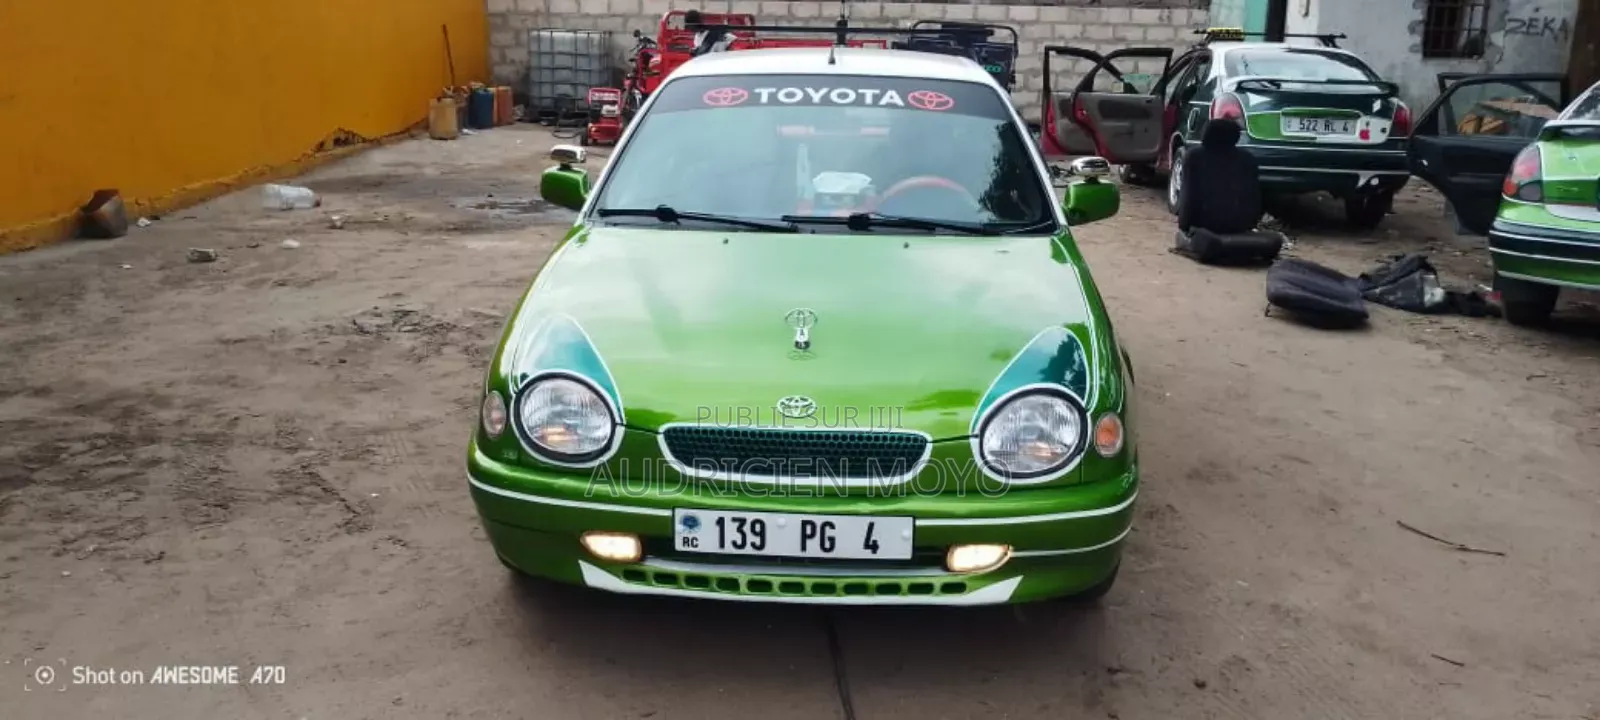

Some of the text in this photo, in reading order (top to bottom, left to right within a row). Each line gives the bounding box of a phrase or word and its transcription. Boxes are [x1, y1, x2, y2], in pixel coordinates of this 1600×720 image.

[753, 86, 904, 107] TOYOTA
[1299, 119, 1318, 132] 522
[1342, 120, 1349, 132] 4
[682, 536, 700, 549] RC
[715, 515, 880, 555] 139 PG 4
